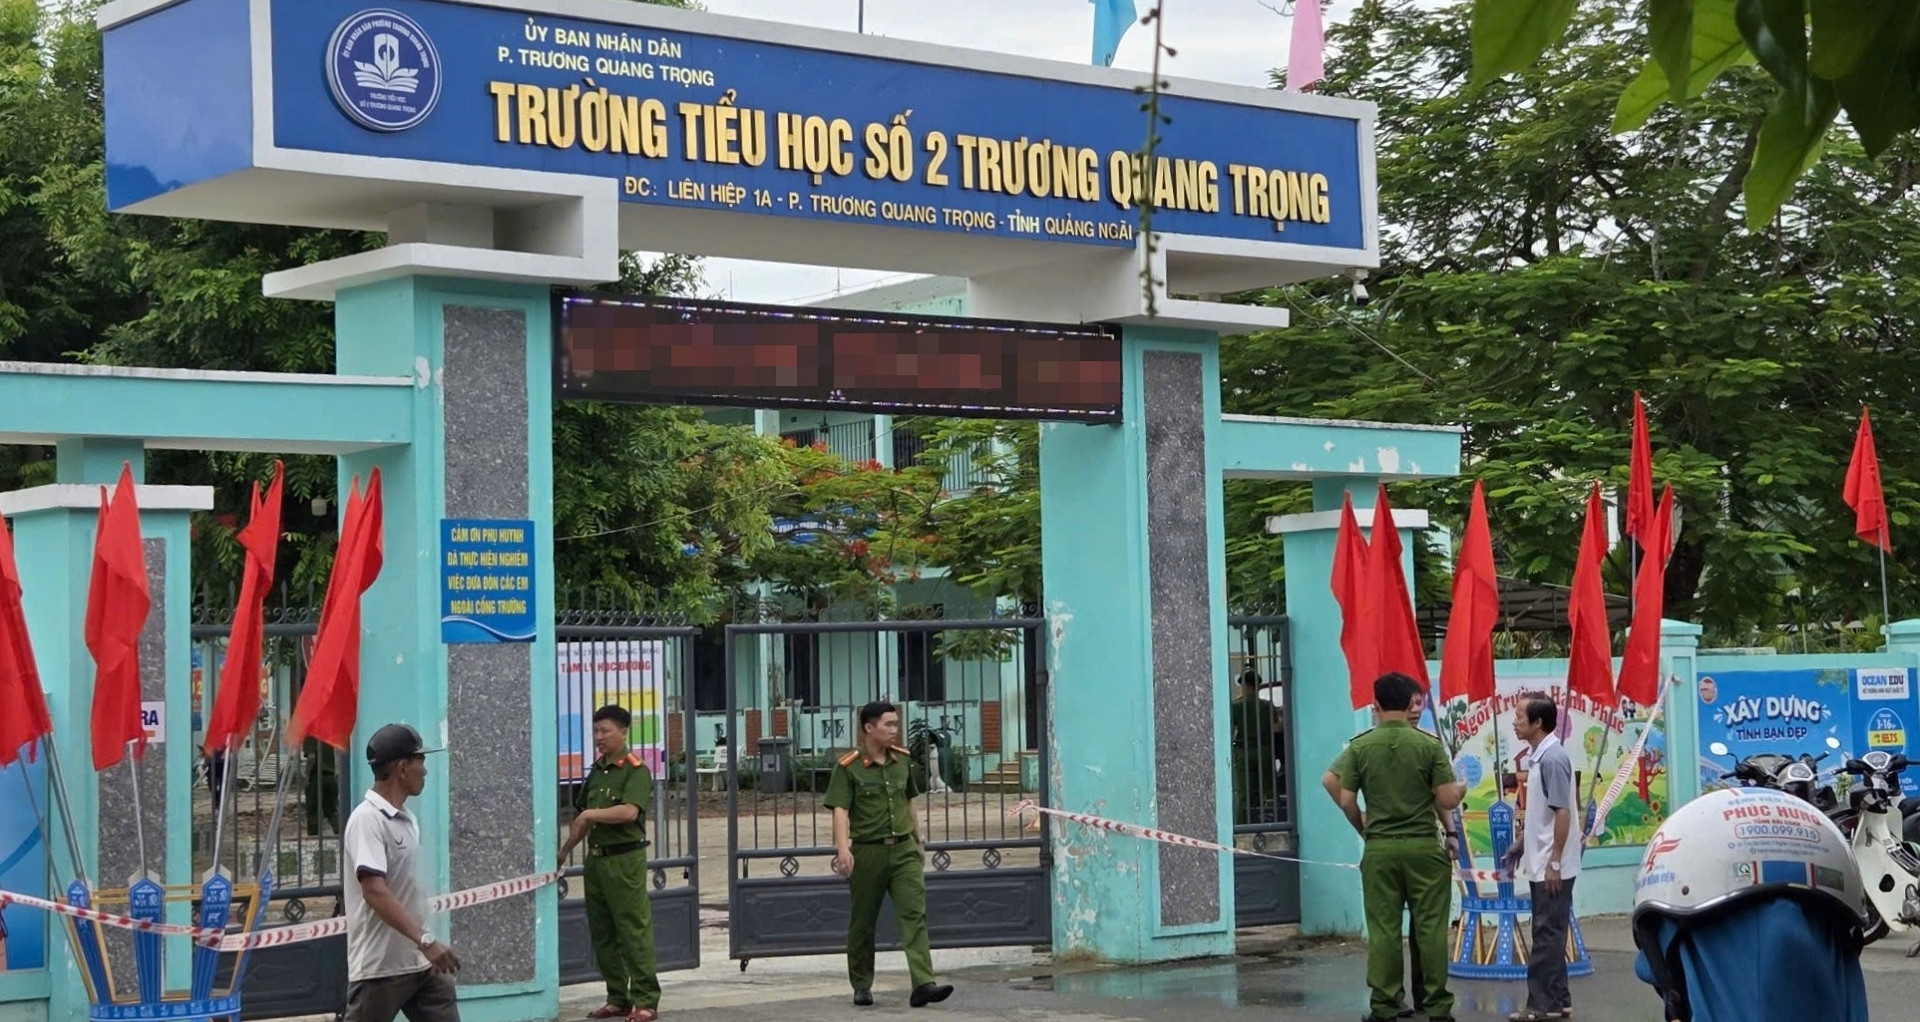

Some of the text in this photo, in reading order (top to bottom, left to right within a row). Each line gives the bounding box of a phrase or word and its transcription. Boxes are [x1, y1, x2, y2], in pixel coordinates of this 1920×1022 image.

[525, 17, 681, 58] ỦY BAN NHÂN DÂN
[498, 46, 714, 88] P. TRƯƠNG QUANG TRỌNG
[489, 77, 1330, 232] TRƯỜNG TIỂU HỌC SỐ 2 TRƯƠNG QUANG TRỌNG
[668, 178, 705, 201] LIÊN
[711, 182, 746, 208] HIỆP
[753, 189, 772, 208] 1A
[789, 191, 803, 210] P.
[810, 194, 877, 218] TRƯƠNG
[881, 201, 937, 224] QUANG
[942, 208, 996, 232] TRỌNG
[1007, 208, 1040, 234] TỈNH
[1044, 212, 1094, 238] QUẢNG
[1098, 219, 1133, 240] NGÃI
[482, 528, 498, 546] PHỤ
[499, 528, 524, 543] HUYNH
[447, 549, 528, 569] ĐÃ THỰC HIỆN NGHIÊM
[448, 573, 528, 593] VIỆC ĐƯA ĐÓN CÁC EM
[451, 597, 474, 614] NGOÀI
[497, 597, 527, 614] TRƯỜNG
[1862, 675, 1904, 685] OCEAN EDU
[1723, 694, 1820, 725] XÂY DỰNG
[1787, 726, 1807, 740] ĐẸP
[1723, 804, 1772, 821] PHÚC
